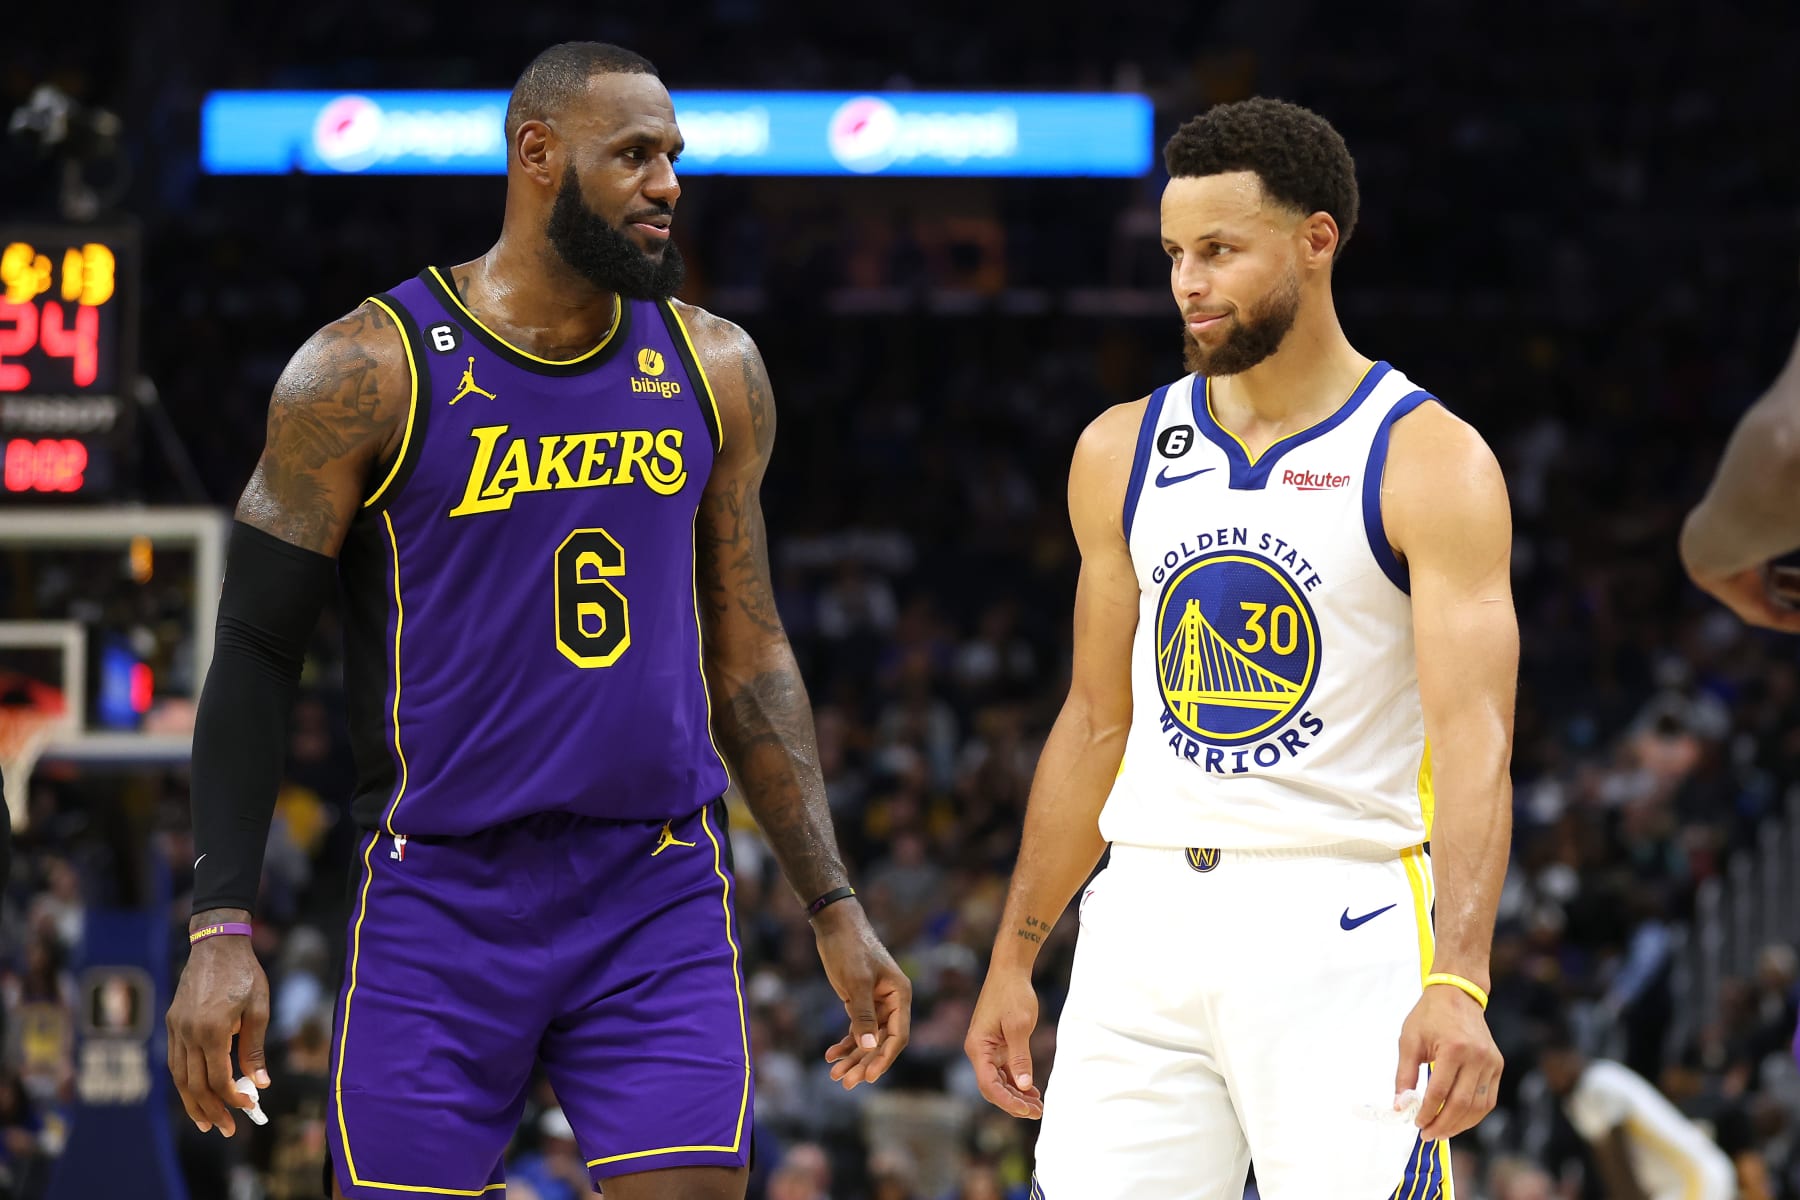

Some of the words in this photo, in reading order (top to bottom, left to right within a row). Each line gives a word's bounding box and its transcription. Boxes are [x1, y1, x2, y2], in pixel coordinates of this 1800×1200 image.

[0, 299, 99, 391] 24
[430, 325, 456, 352] 6
[631, 376, 681, 398] bibigo
[448, 424, 688, 518] LAKERS
[1164, 428, 1189, 455] 6
[1282, 469, 1350, 489] Rakuten
[1152, 527, 1248, 585] GOLDEN
[1258, 532, 1323, 593] STATE
[554, 526, 632, 669] 6
[1236, 601, 1299, 656] 30
[1159, 706, 1324, 774] WARRIORS
